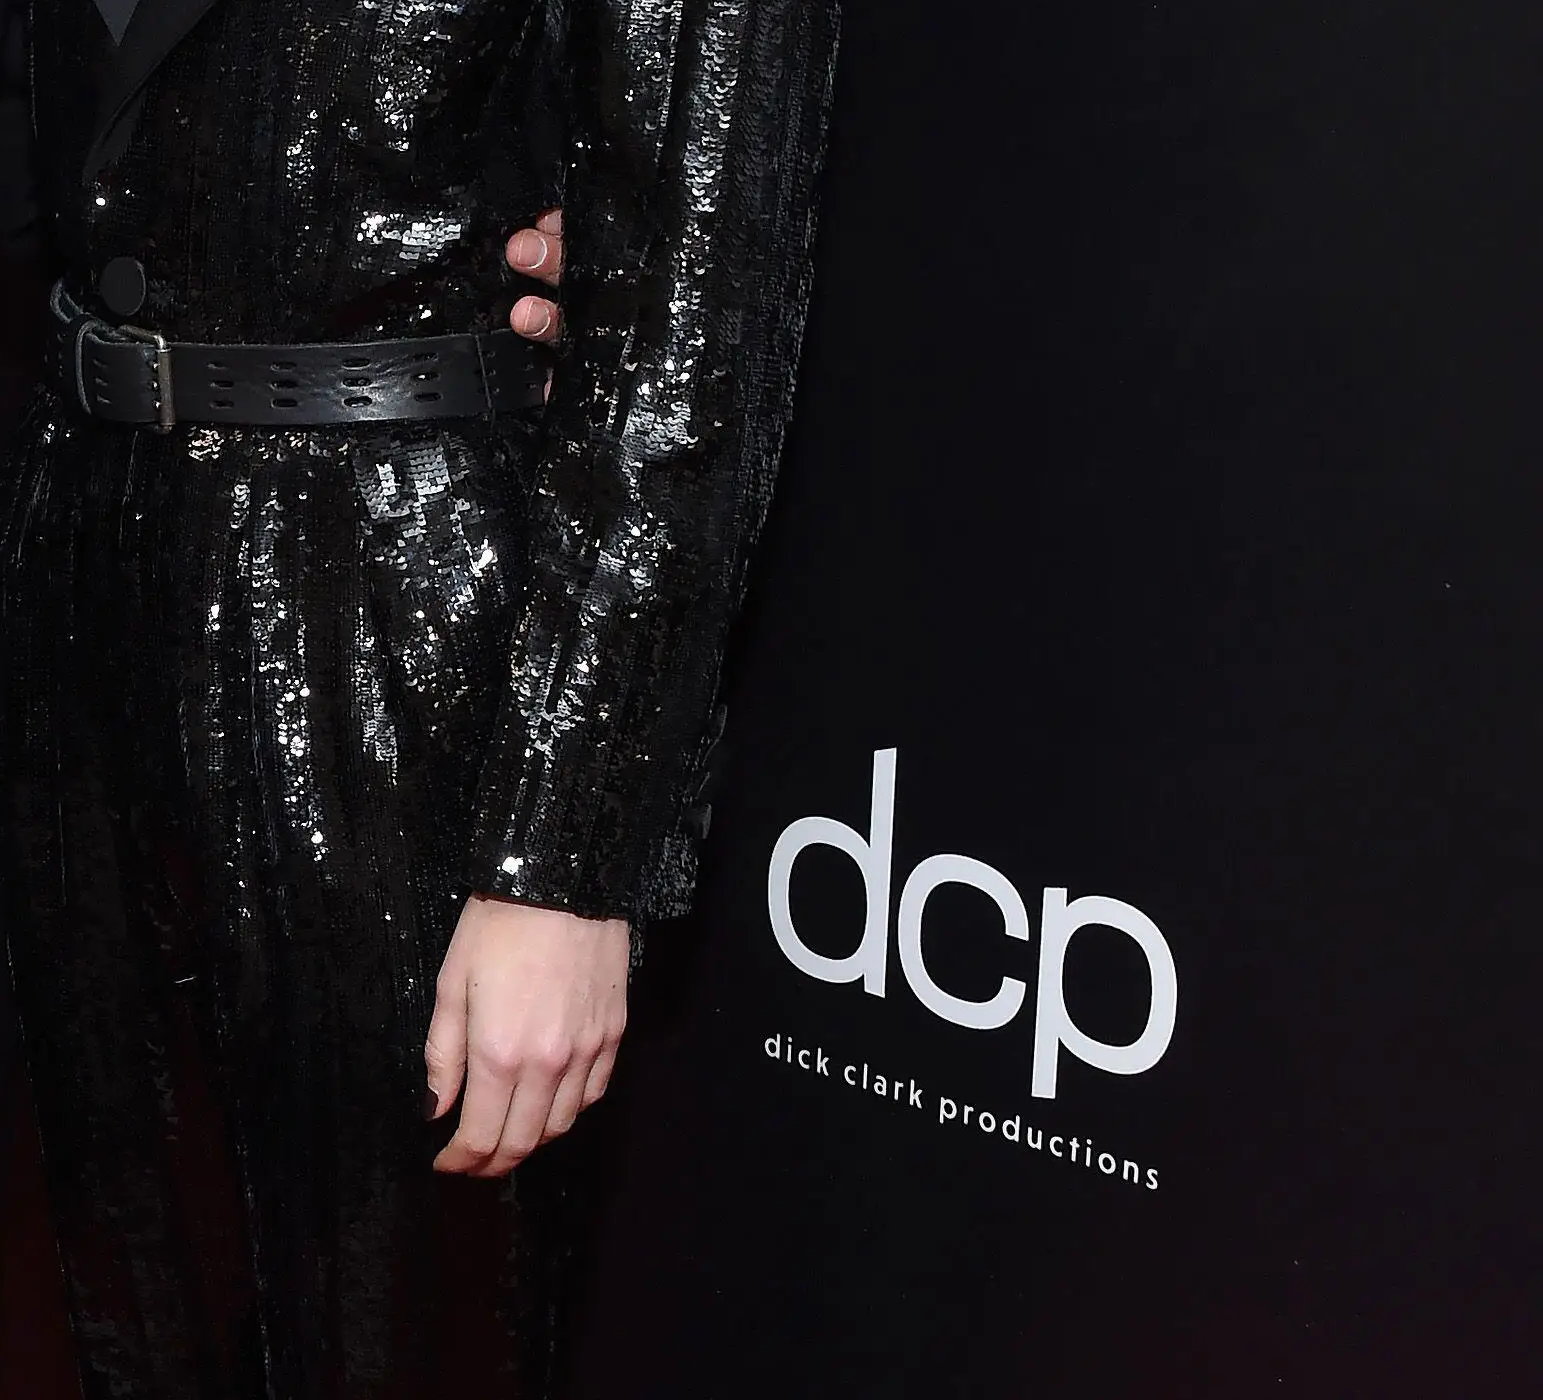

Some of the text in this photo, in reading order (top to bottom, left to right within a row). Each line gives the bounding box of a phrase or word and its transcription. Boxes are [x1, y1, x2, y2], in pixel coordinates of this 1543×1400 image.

[768, 747, 1178, 1100] dcp
[764, 1034, 1160, 1191] dick clark productions
